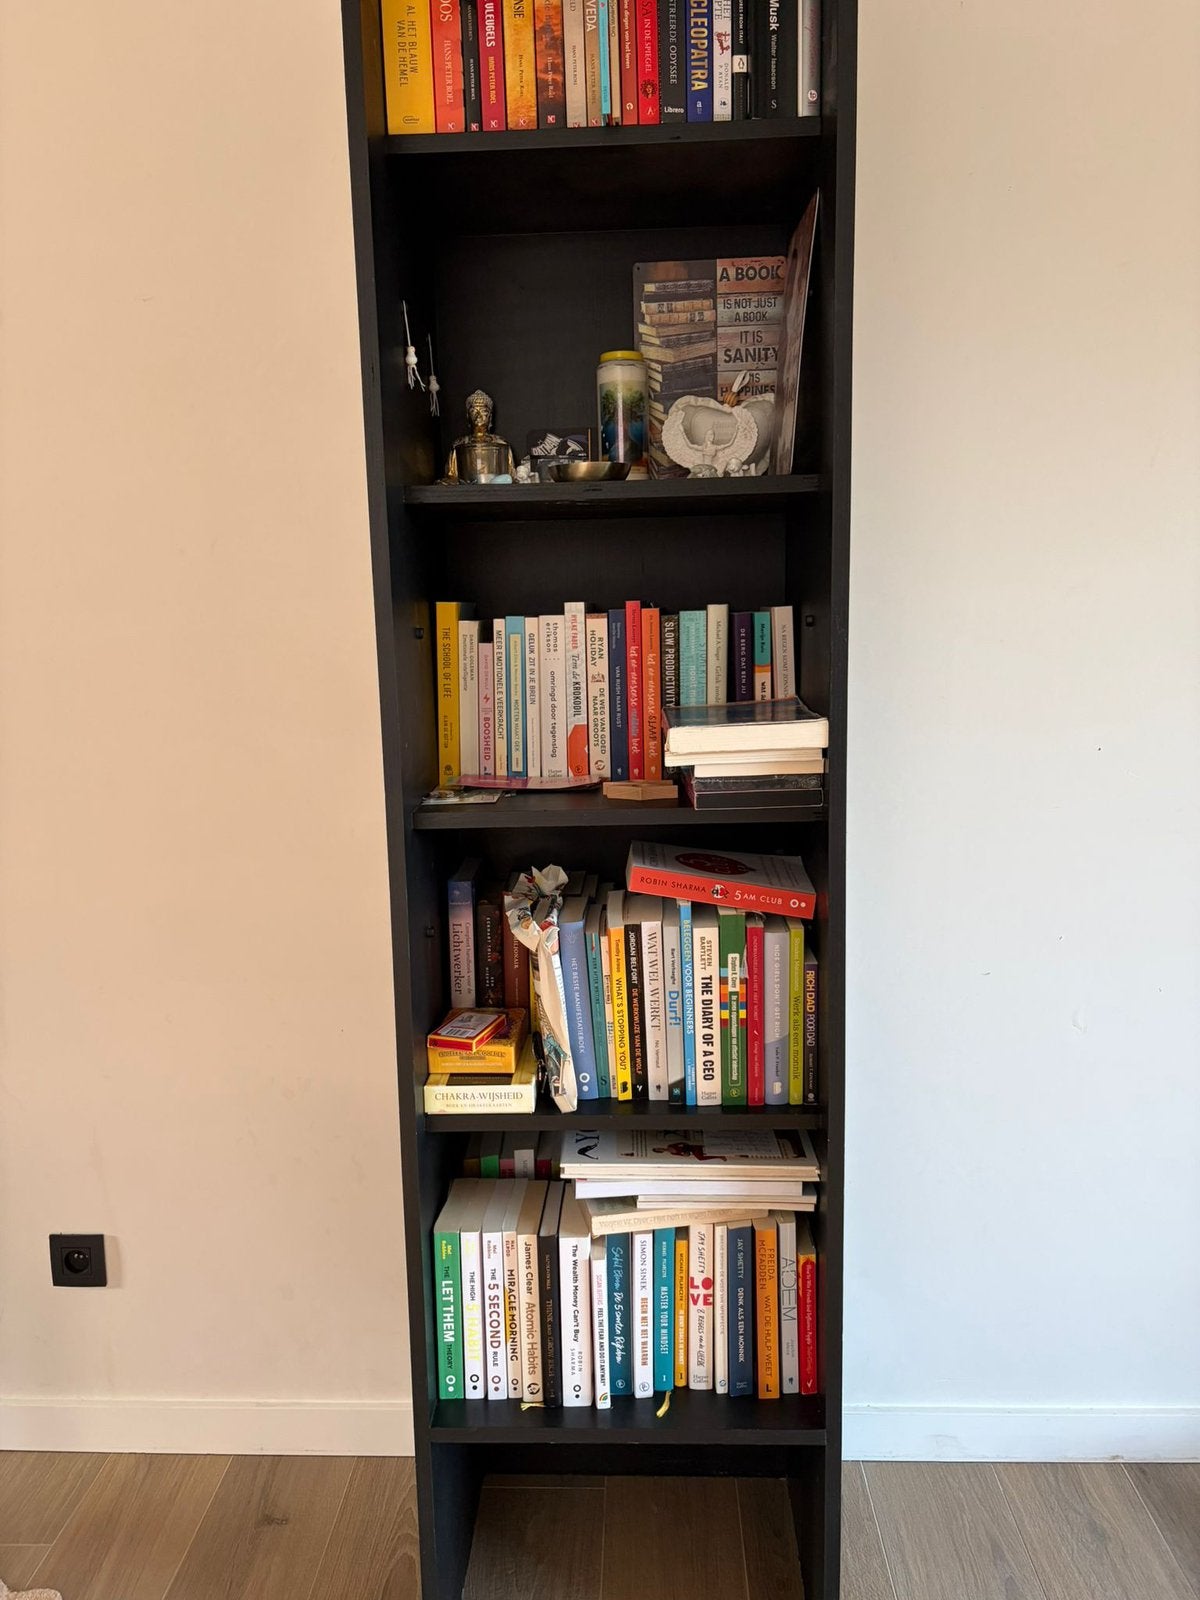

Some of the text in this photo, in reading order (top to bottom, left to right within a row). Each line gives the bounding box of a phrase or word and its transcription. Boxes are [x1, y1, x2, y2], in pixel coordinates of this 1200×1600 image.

[770, 0, 779, 30] Musk
[397, 20, 408, 88] VAN DE HEMEL
[407, 5, 418, 74] AL HET BLAUW
[690, 0, 708, 90] CLEOPATRA
[444, 40, 454, 104] HANS PETER ROEL
[644, 41, 652, 74] SPIEGEL
[669, 45, 677, 84] ODYSSEE
[664, 106, 684, 114] Librero
[719, 264, 781, 282] A BOOK
[723, 297, 777, 309] IS NOT JUST
[734, 311, 767, 322] A BOOK
[740, 331, 763, 344] IT IS
[723, 346, 778, 363] SANITY
[528, 633, 536, 654] GELUK
[442, 627, 451, 698] THE SCHOOL OF LIFE
[664, 622, 675, 707] SLOW PRODUCTIVITY
[529, 676, 536, 684] JE
[571, 653, 582, 717] Tem de KROKODIL
[599, 688, 605, 698] DE
[483, 716, 491, 760] BOOSHEID
[550, 722, 558, 758] tegenslag
[640, 876, 783, 905] ROBIN SHARMA 5 AM CLUB
[452, 923, 464, 995] Lichtwerker
[629, 931, 637, 956] JORDAN
[572, 972, 580, 990] BESTE
[630, 957, 638, 984] BELFORT
[647, 932, 661, 1031] WAT WEL WERKT
[683, 920, 694, 1034] BELEGGEN VOOR BEGINNERS
[701, 975, 713, 997] THE
[632, 988, 639, 996] DE
[792, 996, 801, 1017] Werk
[573, 992, 585, 1054] MANIFESTATIEBOEK
[632, 996, 640, 1034] WERKWIJZE
[669, 990, 681, 1026] Durf!
[701, 999, 713, 1030] DIARY
[806, 971, 815, 1046] RICH DAD POOR DAD
[615, 978, 627, 1070] WHAT'S STOPPING YOU?
[793, 1019, 801, 1031] als
[634, 1035, 642, 1047] VAN
[703, 1034, 714, 1048] OF
[703, 1060, 714, 1080] CEO
[793, 1049, 802, 1080] monnik
[434, 1092, 523, 1102] CHAKRA-WIJSHEID
[697, 1231, 705, 1274] JAY SHETTY
[759, 1239, 767, 1290] MCFADDEN
[441, 1280, 453, 1302] LET
[571, 1286, 579, 1307] Money
[690, 1277, 713, 1290] LO
[507, 1269, 518, 1361] MIRACLE MORNING
[524, 1242, 539, 1375] James Clear Atomic Habits
[690, 1294, 713, 1306] VE
[443, 1306, 455, 1342] THEM
[488, 1295, 501, 1348] SECOND
[660, 1286, 668, 1354] MASTER YOUR MINDSET
[765, 1316, 771, 1326] DE
[467, 1316, 480, 1361] HABIT
